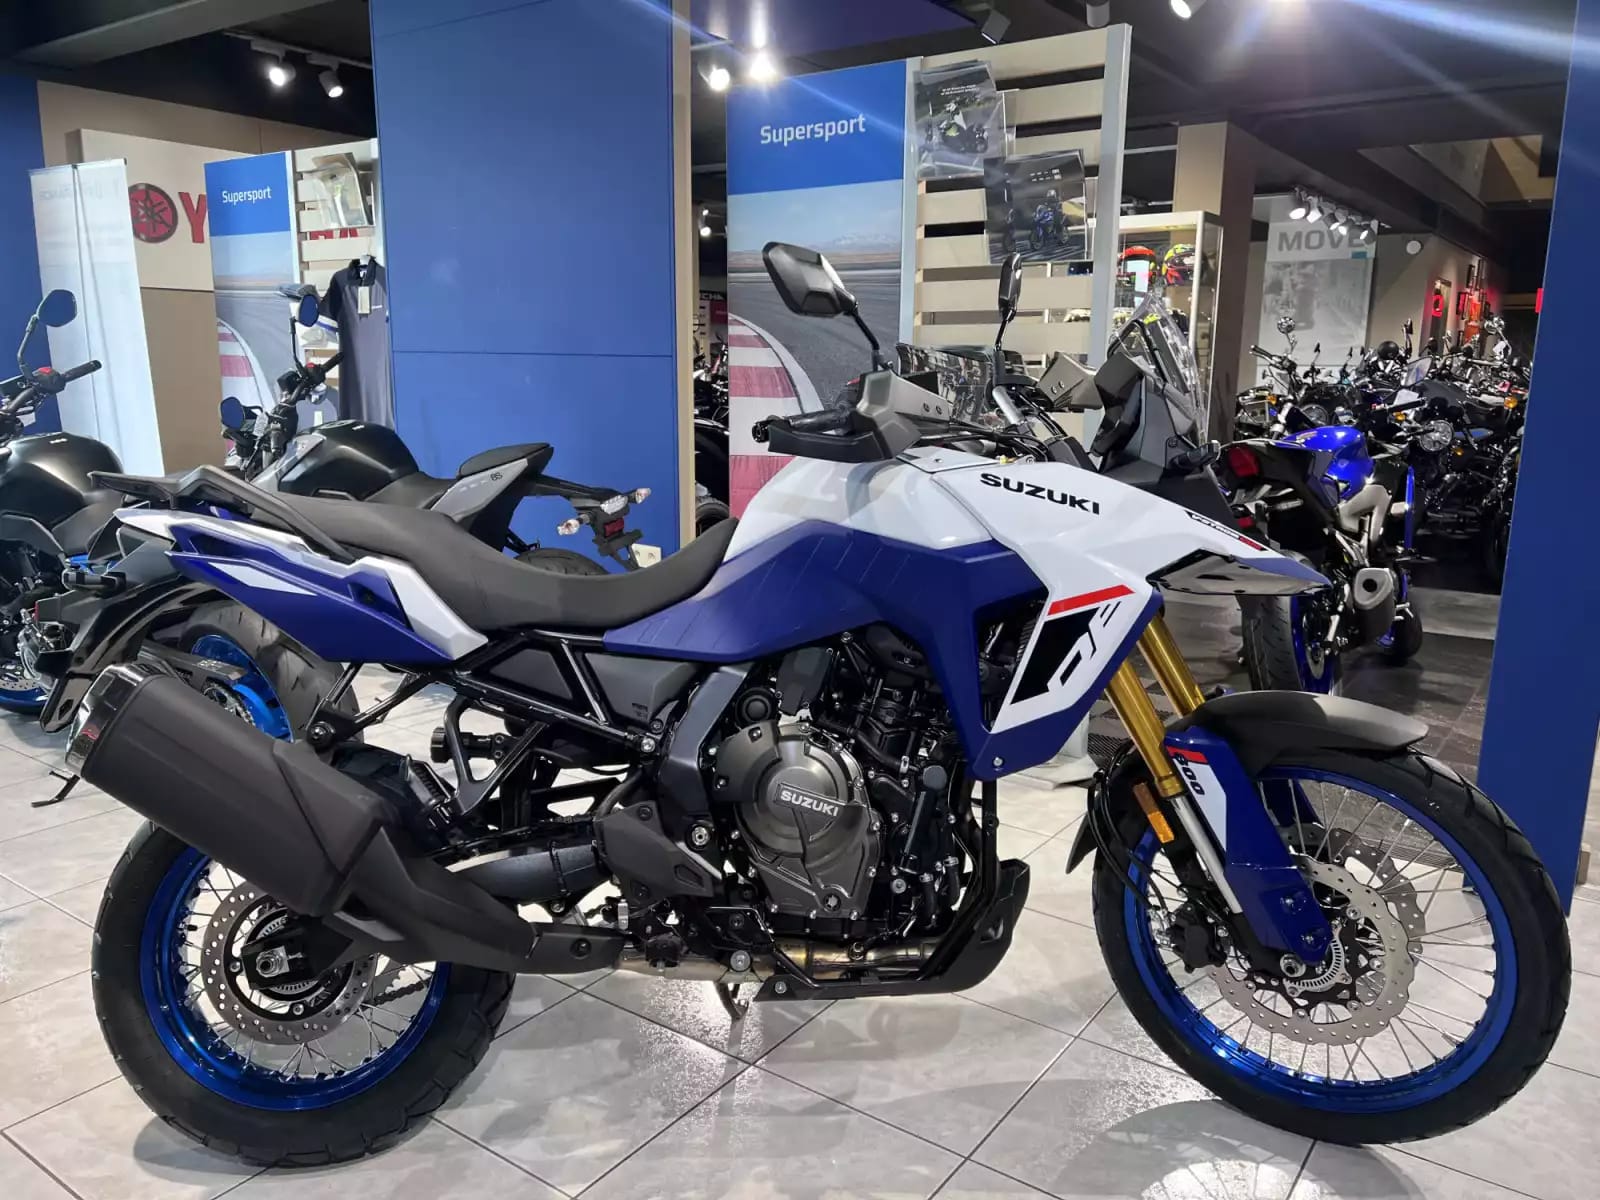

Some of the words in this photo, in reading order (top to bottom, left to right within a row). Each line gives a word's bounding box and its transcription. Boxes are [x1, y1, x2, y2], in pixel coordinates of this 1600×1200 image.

[760, 113, 866, 147] Supersport
[222, 185, 272, 205] Supersport
[980, 472, 1100, 515] SUZUKI
[780, 789, 839, 817] SUZUKI
